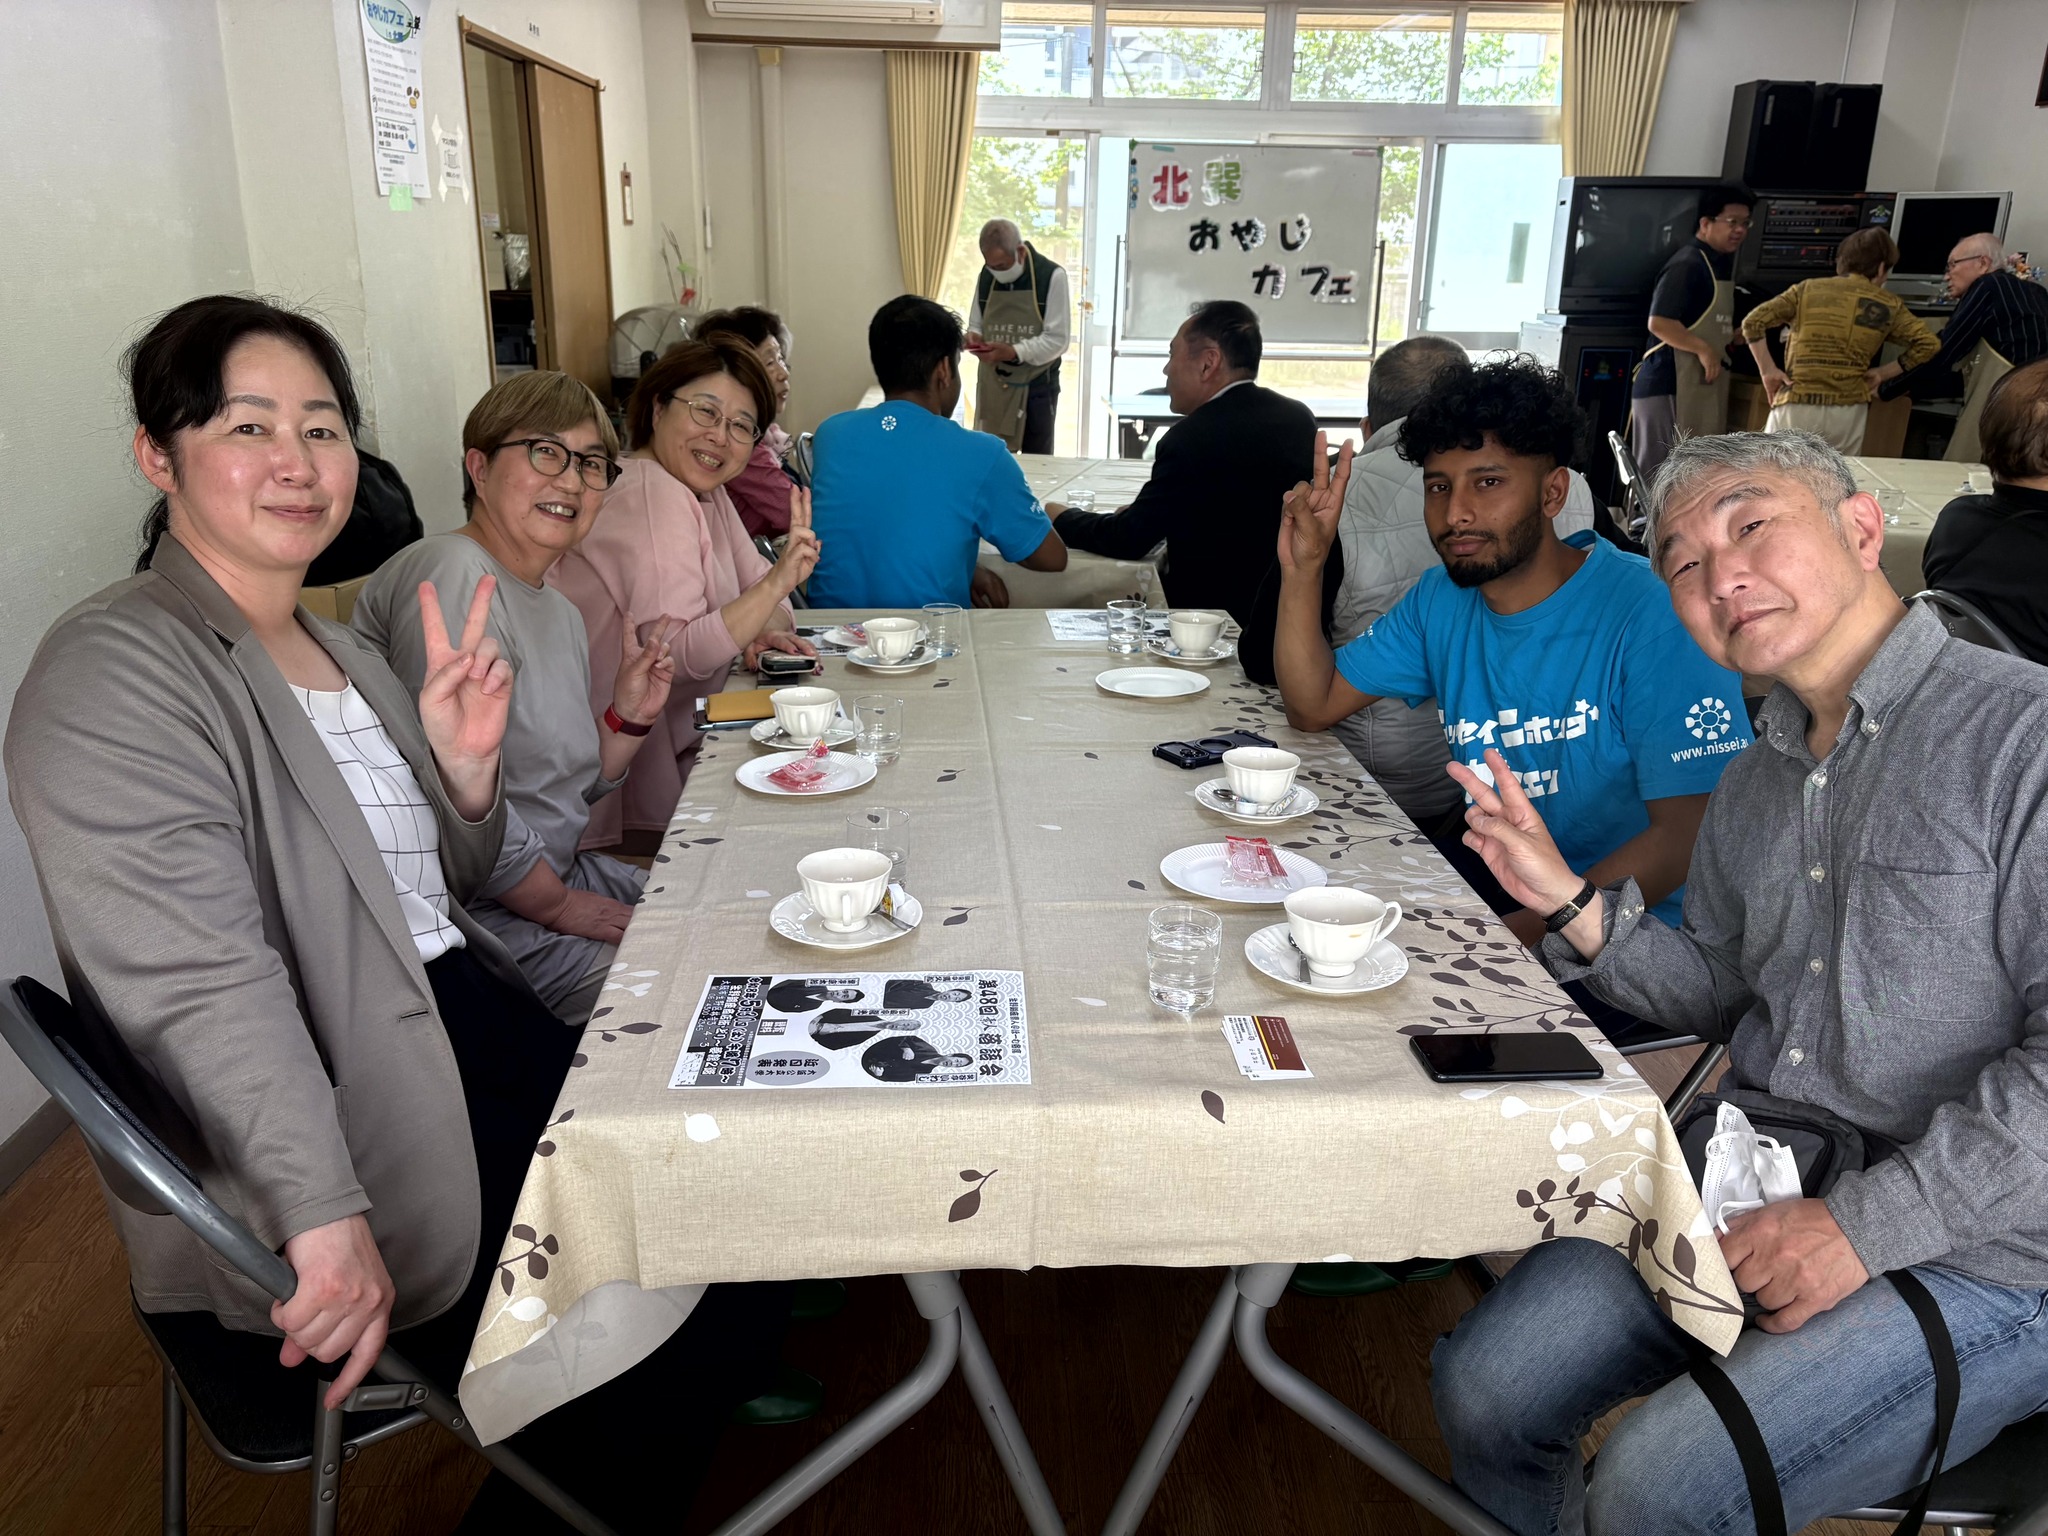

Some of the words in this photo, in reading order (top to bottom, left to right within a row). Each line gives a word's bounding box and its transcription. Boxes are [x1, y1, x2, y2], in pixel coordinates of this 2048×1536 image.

[1153, 161, 1242, 205] 北巽
[1189, 216, 1310, 252] おやじ
[1252, 264, 1354, 298] カフェ
[1017, 324, 1035, 335] ME
[757, 1058, 820, 1067] 近日発表
